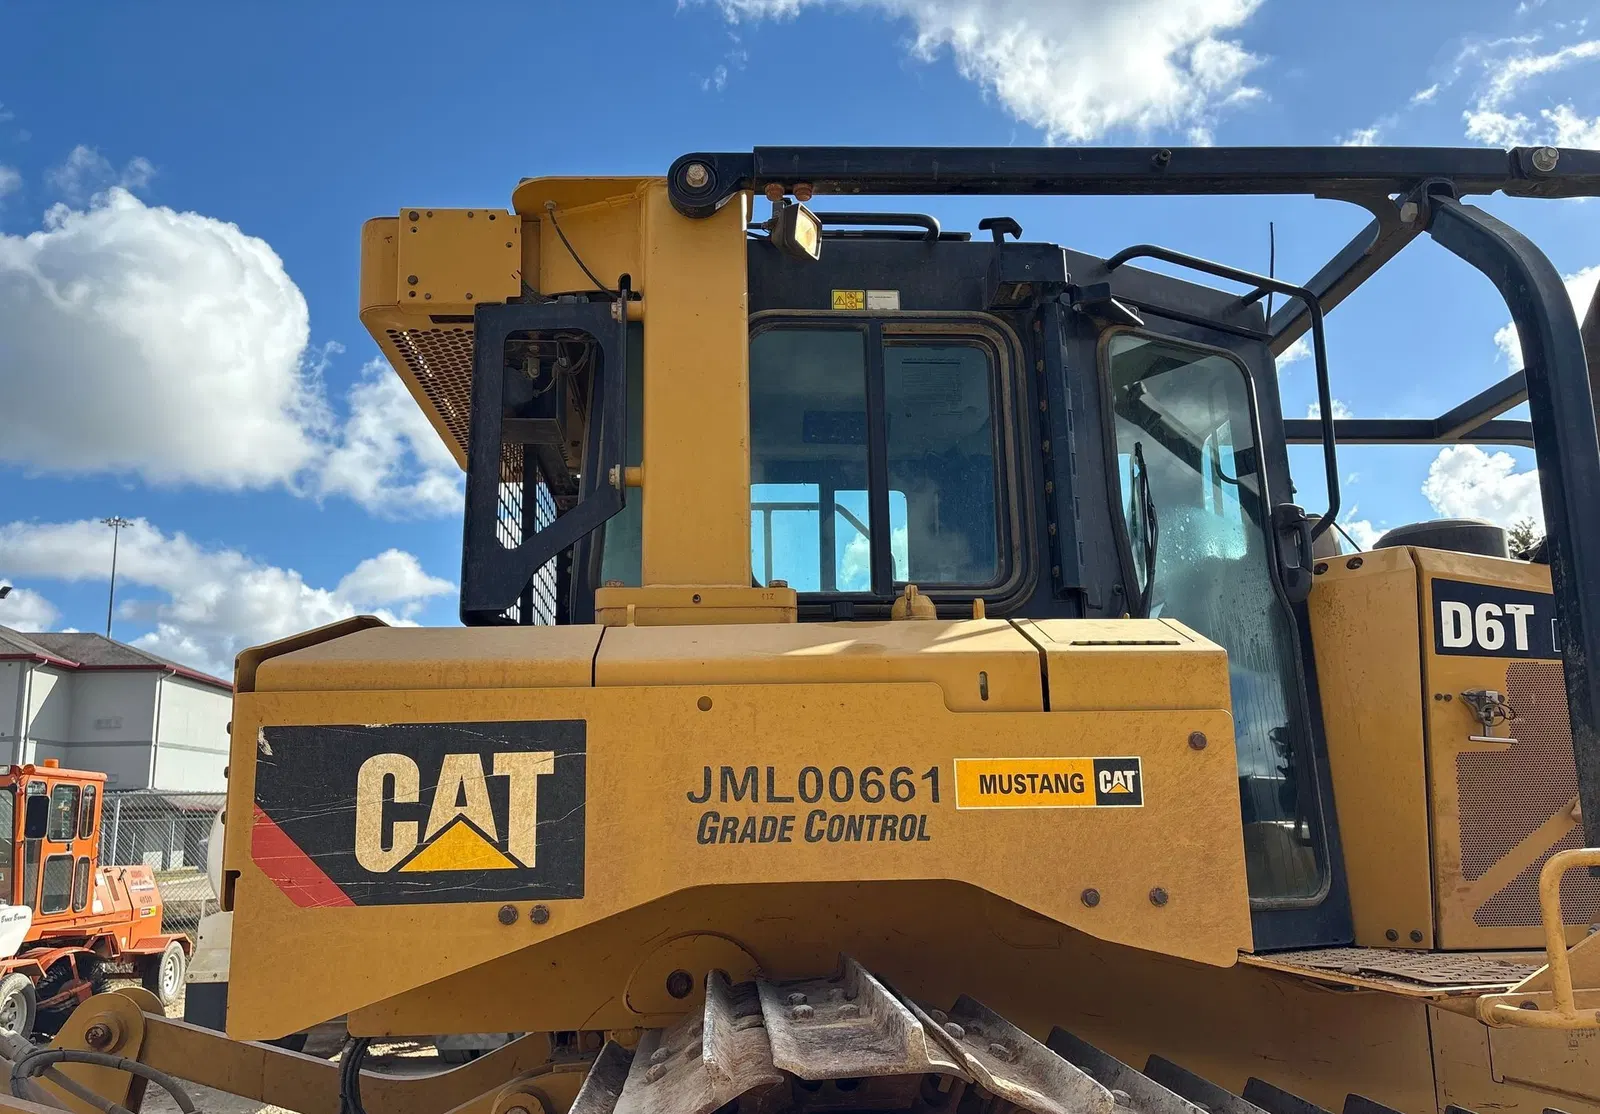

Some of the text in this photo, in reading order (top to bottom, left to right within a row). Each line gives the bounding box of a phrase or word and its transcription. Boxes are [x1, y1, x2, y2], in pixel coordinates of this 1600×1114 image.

[1440, 601, 1535, 651] D6T
[686, 765, 942, 804] JML00661
[979, 770, 1136, 795] MUSTANG CAT
[355, 751, 555, 874] CAT
